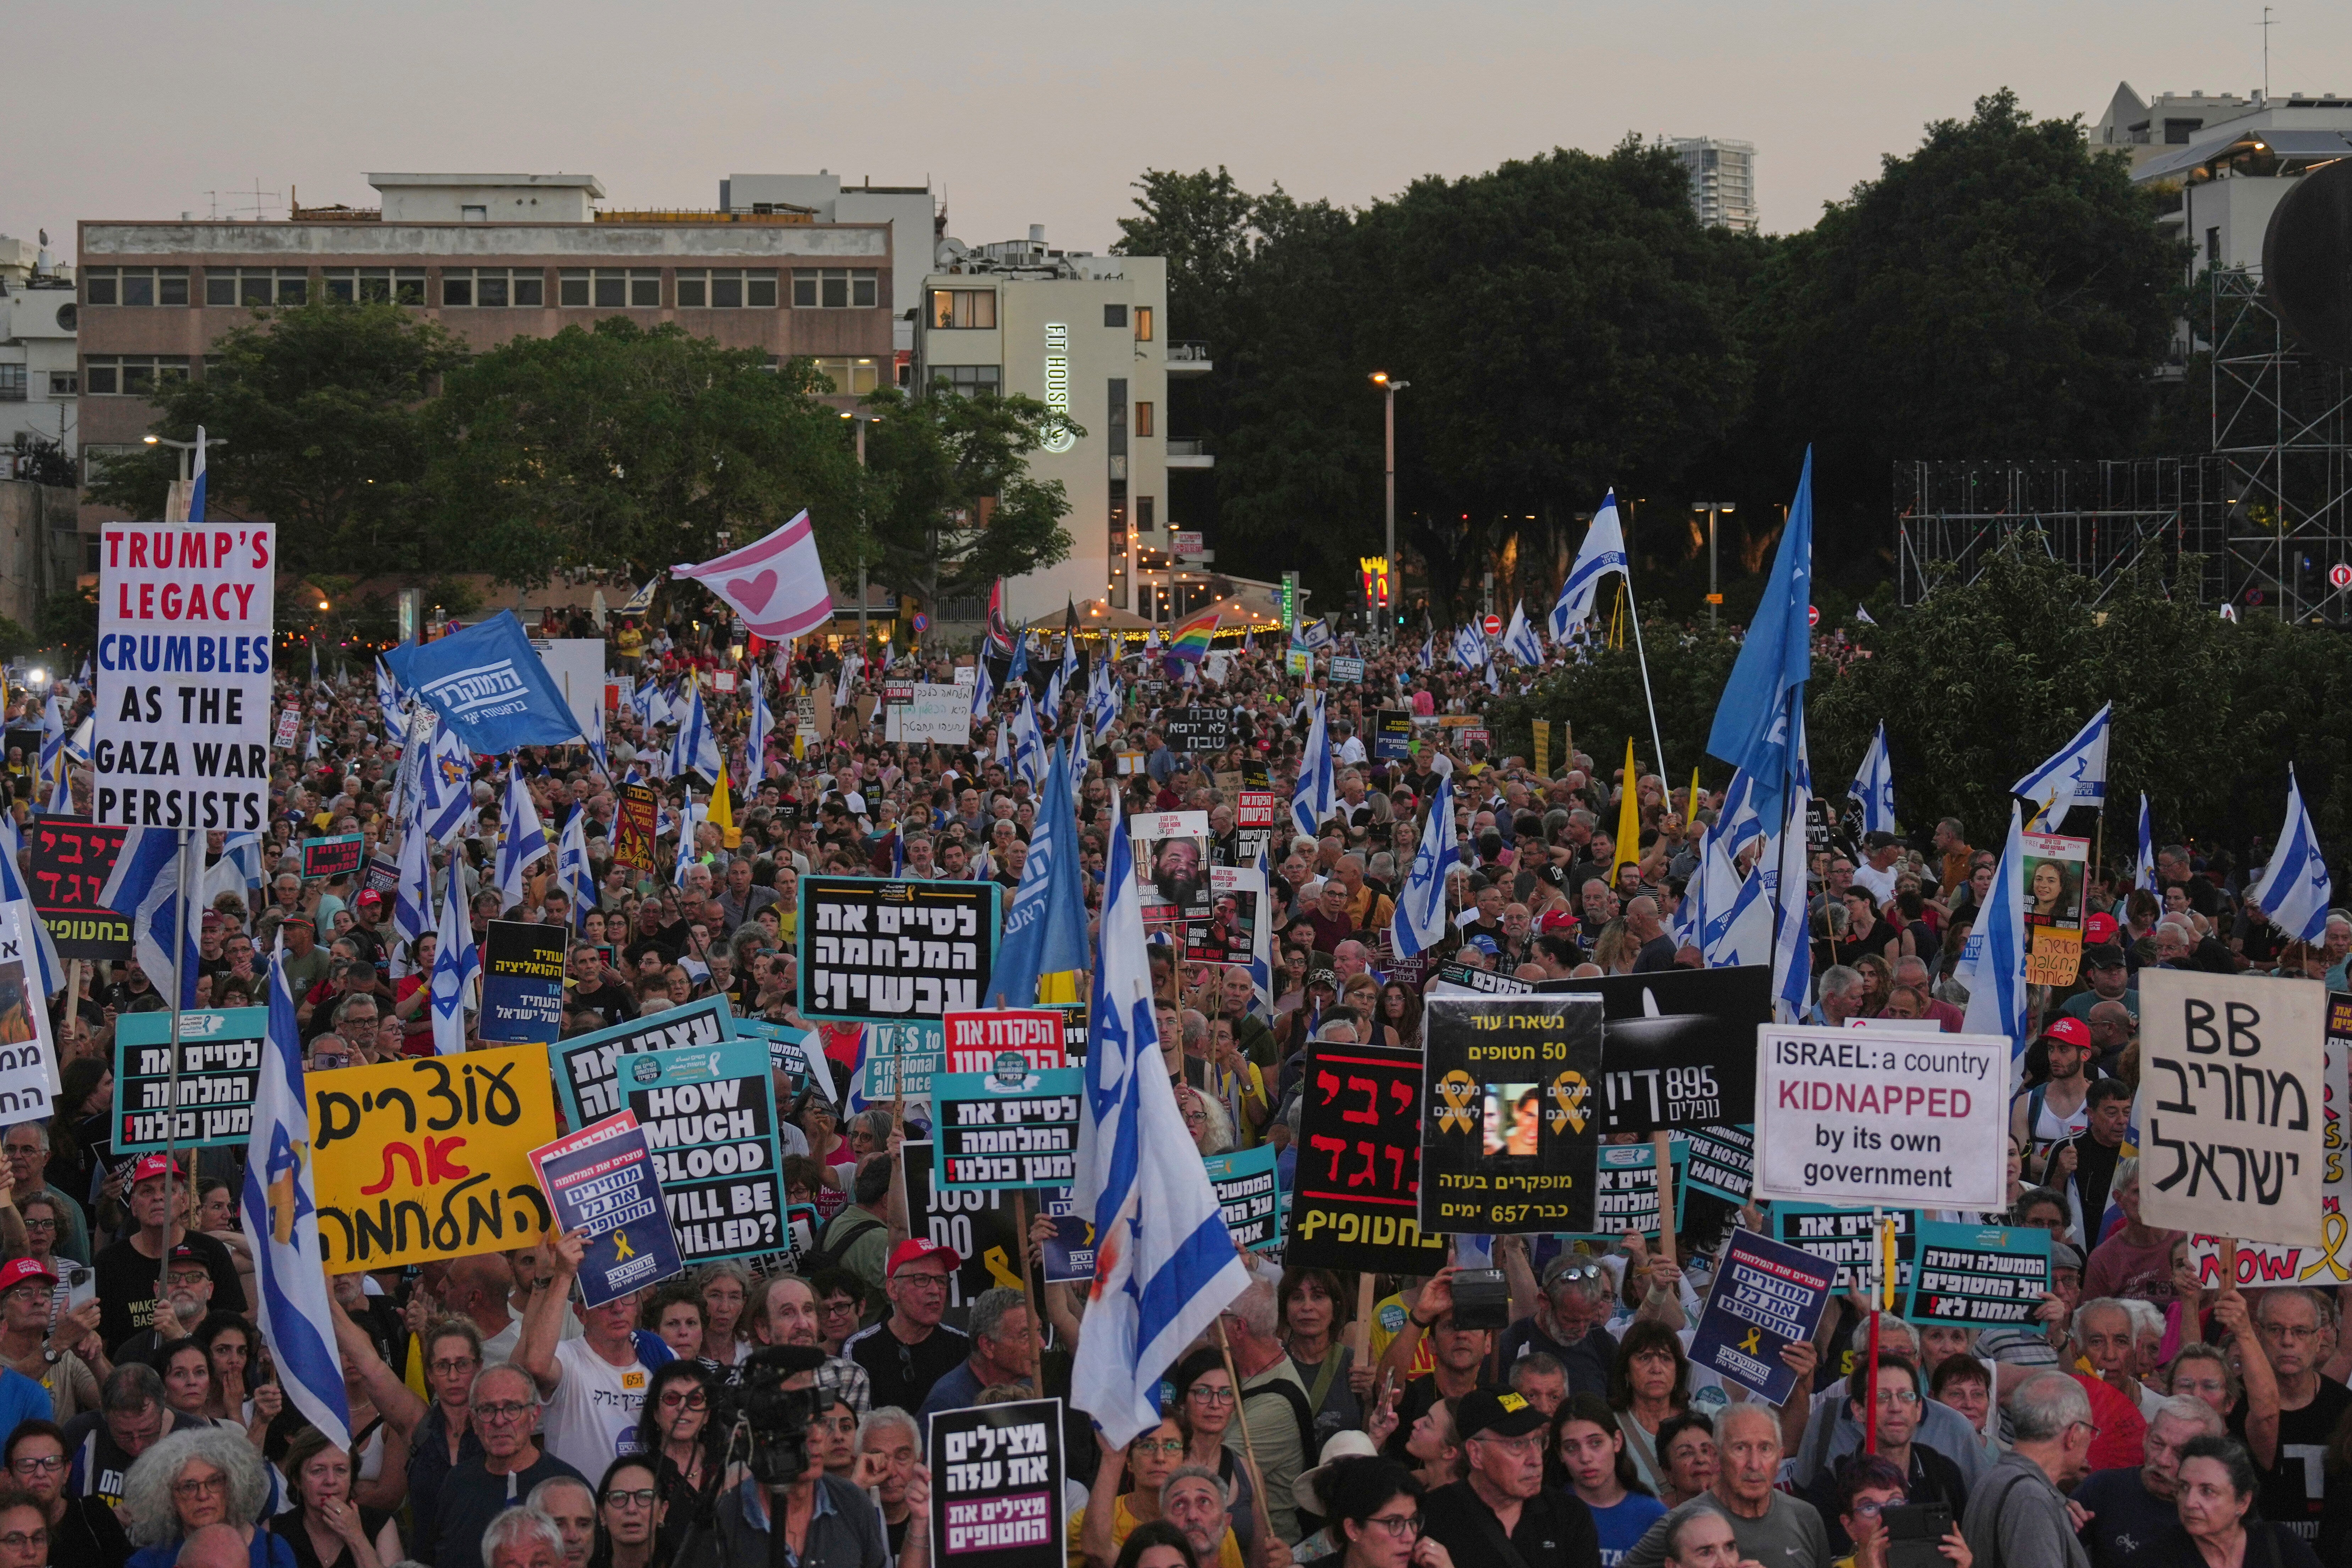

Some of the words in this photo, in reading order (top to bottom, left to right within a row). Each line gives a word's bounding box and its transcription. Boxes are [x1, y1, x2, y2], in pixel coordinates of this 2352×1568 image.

[1047, 324, 1066, 351] FIT
[1048, 356, 1067, 412] HOUSE
[106, 531, 269, 569] TRUMP'S
[119, 583, 254, 620] LEGACY
[99, 633, 269, 673] CRUMBLES
[888, 688, 900, 697] 7.10
[902, 688, 912, 697] את
[905, 679, 913, 688] לא
[119, 686, 162, 724] AS
[178, 686, 243, 725] THE
[951, 706, 967, 715] היא
[1189, 709, 1227, 720] טבח
[1170, 723, 1201, 733] ירפא
[1208, 722, 1226, 733] לא
[1187, 736, 1225, 749] טבח
[95, 739, 180, 776] GAZA
[193, 742, 267, 779] WAR
[627, 786, 653, 802] סכנה!
[1242, 796, 1250, 805] את
[1251, 795, 1271, 806] הפקרת
[98, 787, 260, 831] PERSISTS
[1240, 807, 1271, 822] הביטחון
[1238, 830, 1261, 840] להישאר
[318, 842, 360, 854] עוצרות
[342, 852, 357, 861] את
[1138, 885, 1158, 895] BRING
[1139, 896, 1152, 906] HIM
[1142, 906, 1158, 917] HOME
[1160, 905, 1178, 916] NOW!
[817, 903, 868, 932] את
[877, 905, 976, 936] לסיים
[1188, 938, 1200, 946] HIM
[1189, 928, 1207, 937] BRING
[533, 949, 564, 961] עתיד
[815, 936, 976, 970] המלחמה
[1188, 948, 1204, 957] HOME
[495, 961, 562, 977] הקואליציה
[548, 984, 561, 995] או
[814, 970, 977, 1014] עכשיו!
[520, 995, 560, 1009] העתיד
[496, 1006, 537, 1020] ישראל
[541, 1009, 559, 1023] של
[1471, 1016, 1501, 1031] עוד
[1508, 1015, 1565, 1030] נשארו
[955, 1020, 984, 1046] את
[989, 1019, 1055, 1047] הפקרת
[2184, 998, 2261, 1057] BB
[926, 1030, 940, 1050] to
[185, 1040, 258, 1071] לסיים
[1468, 1045, 1535, 1060] חטופים
[1542, 1043, 1567, 1060] 50
[1776, 1041, 1878, 1069] ISRAEL:
[1882, 1050, 1896, 1070] a
[1905, 1049, 1990, 1080] country
[571, 1044, 626, 1084] את
[785, 1058, 805, 1073] על
[874, 1061, 883, 1076] a
[143, 1077, 250, 1108] המלחמה
[1435, 1084, 1481, 1096] מצפים
[1547, 1084, 1592, 1097] מצפים
[1665, 1065, 1718, 1099] 895
[314, 1060, 521, 1149] עוצרים
[648, 1079, 741, 1118] HOW
[1606, 1069, 1660, 1125] די!
[1778, 1080, 1972, 1118] KIDNAPPED
[2152, 1057, 2309, 1131] מחריב
[957, 1102, 996, 1125] את
[1002, 1096, 1077, 1122] לסיים
[1433, 1106, 1481, 1118] לשובם
[1546, 1107, 1592, 1120] לשובם
[1669, 1099, 1720, 1121] נופלים
[642, 1108, 755, 1149] MUCH
[1815, 1123, 1845, 1152] by
[1852, 1125, 1882, 1150] its
[1890, 1133, 1941, 1152] own
[962, 1128, 1070, 1154] המלחמה
[1689, 1137, 1709, 1156] THE
[361, 1136, 470, 1195] את
[597, 1162, 611, 1172] את
[613, 1149, 644, 1165] עוצרים
[654, 1141, 764, 1183] BLOOD
[2151, 1118, 2299, 1205] ישראל
[555, 1168, 594, 1187] המלחמה
[948, 1156, 1017, 1182] כולנו!
[1804, 1159, 1952, 1188] government
[569, 1166, 642, 1203] מחזירים
[1439, 1174, 1488, 1189] בעזה
[1495, 1173, 1572, 1193] מופקרים
[611, 1189, 637, 1208] את
[730, 1182, 773, 1214] BE
[1251, 1195, 1272, 1217] על
[317, 1173, 551, 1263] המלחמה
[582, 1200, 605, 1218] כל
[1441, 1203, 1481, 1217] ימים
[1491, 1205, 1530, 1222] 657
[1537, 1204, 1568, 1217] כבר
[581, 1203, 654, 1237] החטופים
[1799, 1216, 1834, 1237] את
[928, 1216, 973, 1260] DO
[606, 1256, 655, 1280] הדמוקרטים
[1733, 1249, 1774, 1270] המלחמה
[1925, 1248, 1974, 1269] ויתרה
[1977, 1254, 2045, 1275] הממשלה
[2200, 1248, 2302, 1286] NOW
[1775, 1265, 1791, 1276] את
[1793, 1271, 1825, 1287] עוצרים
[1738, 1267, 1810, 1304] מחזירים
[1738, 1285, 1761, 1304] כל
[1922, 1272, 2015, 1298] החטופים
[2018, 1282, 2046, 1299] על
[128, 1299, 158, 1314] WAKE
[1765, 1297, 1795, 1318] את
[1929, 1294, 1978, 1316] לא!
[1982, 1302, 2029, 1321] אנחנו
[1721, 1298, 1801, 1340] החטופים
[1719, 1347, 1769, 1377] הדמוקרטים
[627, 1373, 643, 1386] 657
[945, 1422, 1048, 1461] מצילים
[946, 1460, 1001, 1492] עזה
[1008, 1456, 1048, 1486] את
[950, 1502, 977, 1524] את
[982, 1496, 1046, 1520] מצילים
[950, 1519, 1047, 1549] החטופים
